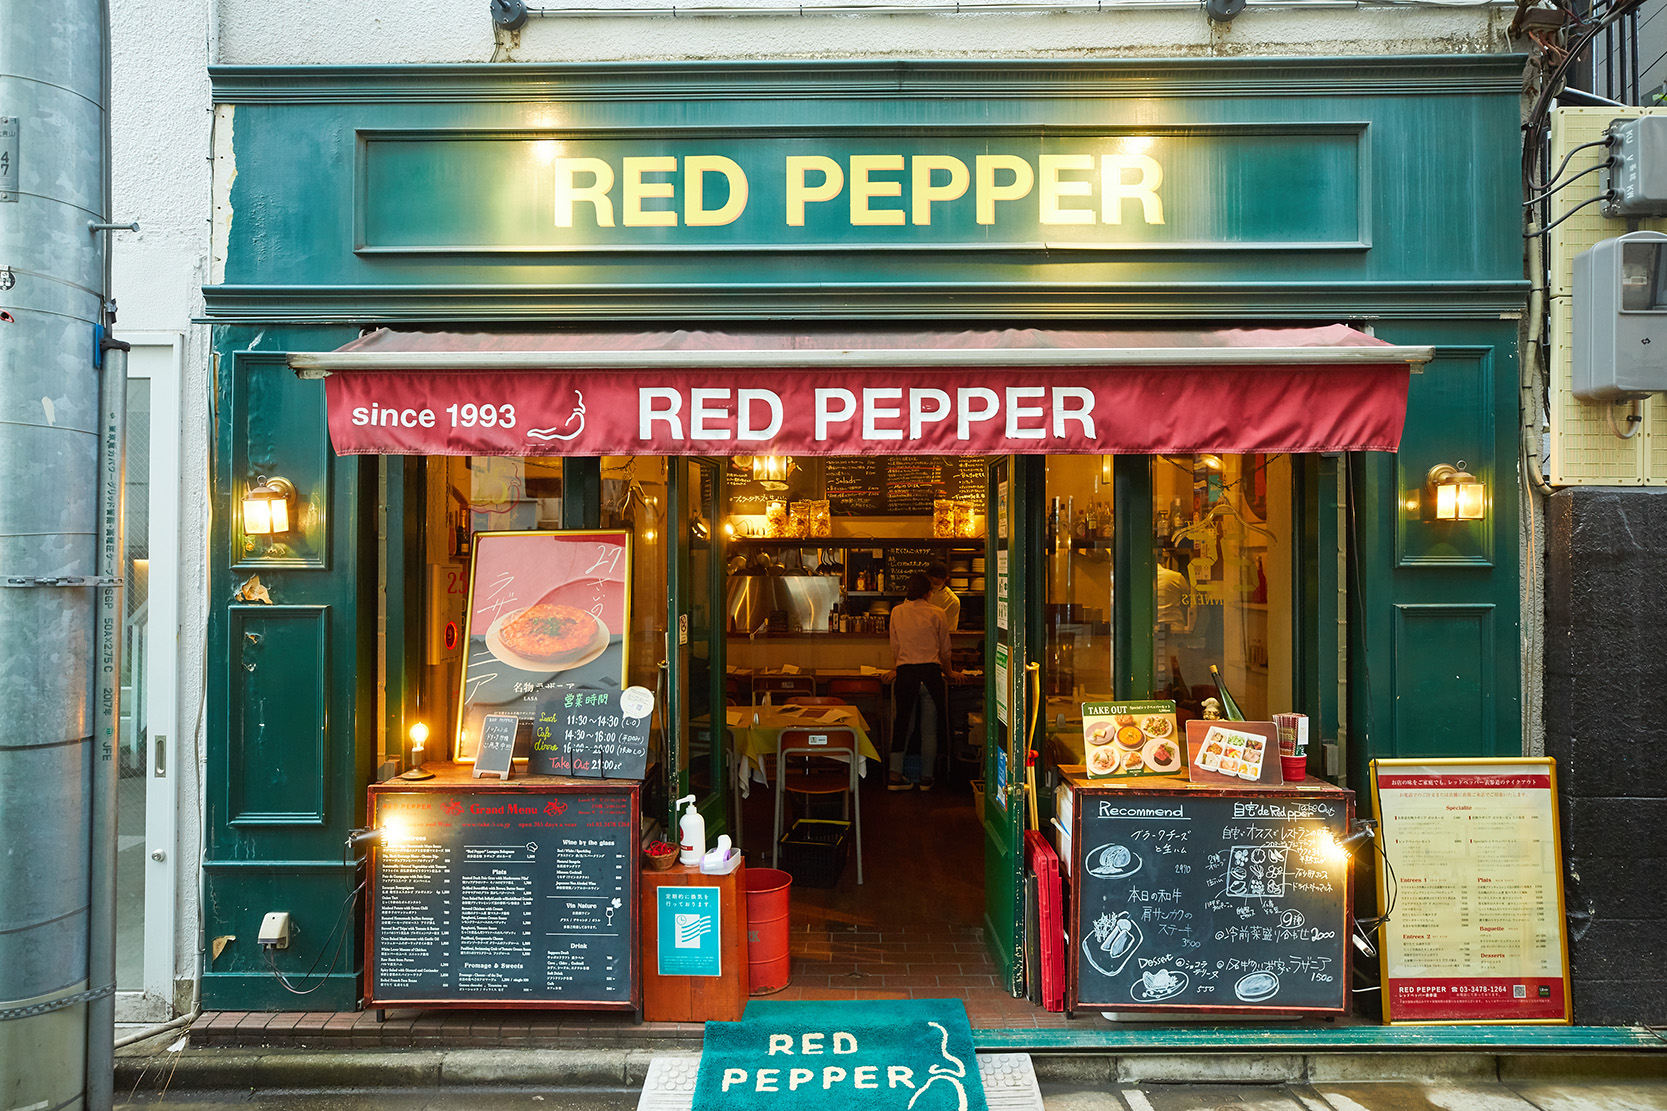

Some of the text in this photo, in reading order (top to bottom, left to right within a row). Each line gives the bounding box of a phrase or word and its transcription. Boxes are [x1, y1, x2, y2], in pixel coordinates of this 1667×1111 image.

[554, 154, 1165, 227] RED PEPPER
[352, 402, 517, 428] since 1993
[638, 386, 1096, 441] RED PEPPER
[564, 693, 608, 708] 営業時間
[103, 742, 112, 761] JFE
[549, 756, 570, 769] Take
[574, 759, 589, 770] Out
[470, 804, 538, 814] Grand Menu
[1099, 800, 1184, 817] Recommend
[1318, 803, 1335, 817] Out
[1155, 844, 1187, 854] と生ハム
[1127, 885, 1182, 903] 本日の和牛
[1141, 906, 1193, 921] 肩サンカクの
[1158, 924, 1192, 937] ステーキ
[1310, 927, 1335, 942] 2000
[1182, 938, 1201, 948] 3500
[1310, 973, 1333, 982] 1500
[768, 1032, 858, 1056] RED
[721, 1065, 916, 1092] PEPPER
